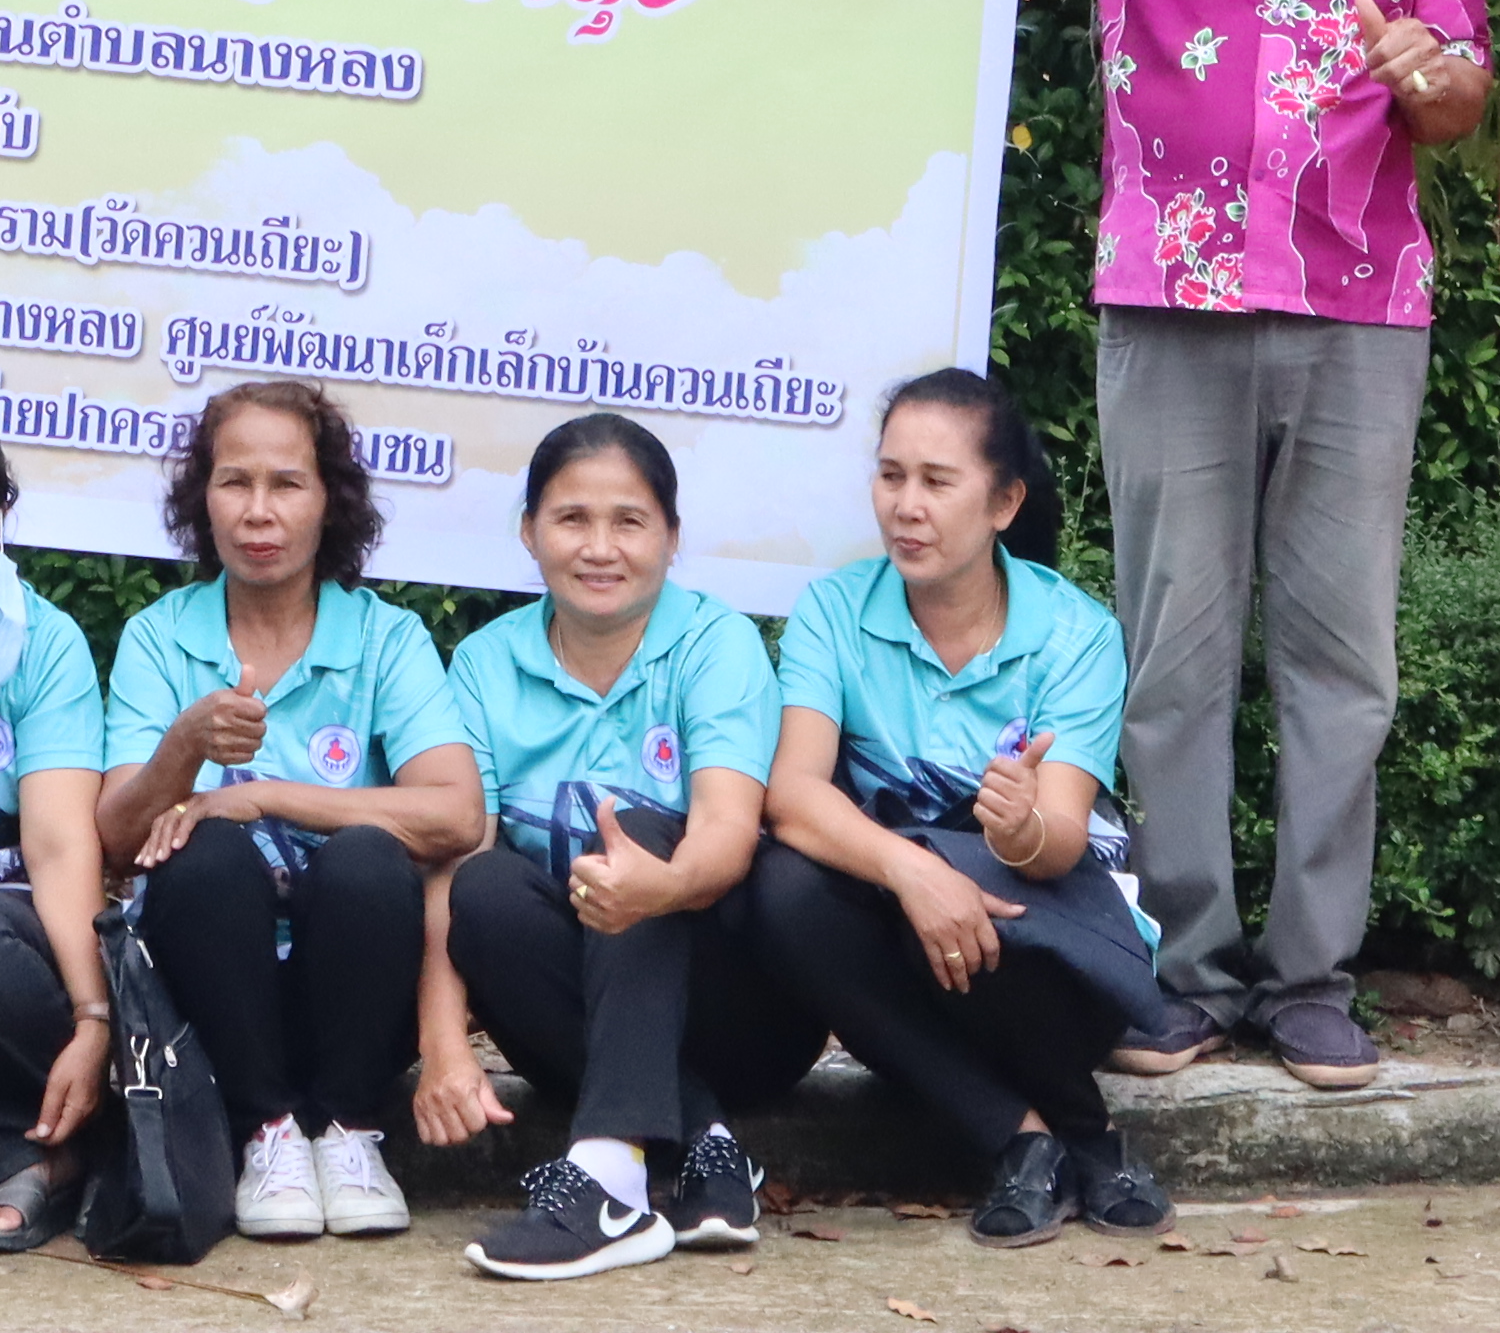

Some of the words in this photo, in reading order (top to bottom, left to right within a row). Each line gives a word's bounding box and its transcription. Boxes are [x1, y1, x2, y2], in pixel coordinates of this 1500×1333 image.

[166, 305, 837, 418] ศูนย์พัฒนาเด็กเล็กบ้านควนเถียะ
